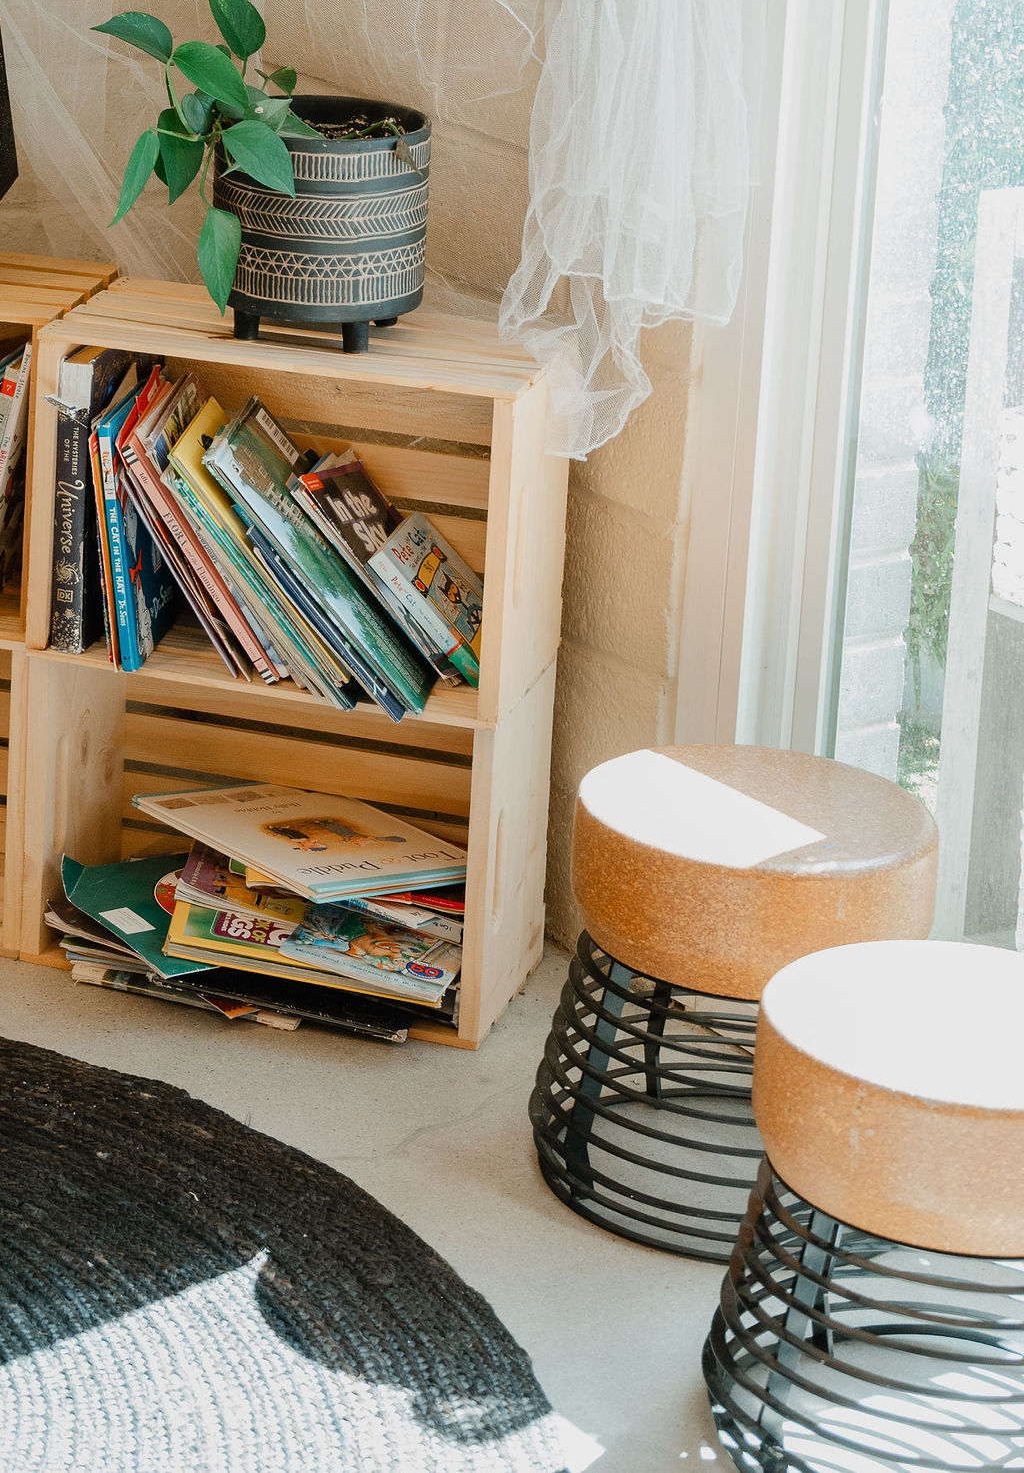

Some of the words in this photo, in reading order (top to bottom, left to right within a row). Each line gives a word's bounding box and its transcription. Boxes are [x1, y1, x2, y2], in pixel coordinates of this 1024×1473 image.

[5, 384, 12, 392] 7
[64, 438, 70, 448] OF
[71, 440, 79, 476] MYSTERIES
[325, 494, 354, 523] In
[343, 489, 378, 518] the
[56, 479, 85, 554] Universe
[109, 507, 117, 524] THE
[111, 527, 120, 544] CAT
[113, 546, 120, 556] IN
[391, 543, 414, 565] Pete
[407, 526, 427, 547] Cat
[114, 557, 122, 573] THE
[163, 512, 187, 547] FLORA
[196, 566, 221, 603] Flamingo
[116, 575, 125, 594] HAT
[391, 576, 403, 592] Pete
[406, 593, 417, 607] Cat
[58, 590, 72, 601] DK
[120, 608, 128, 627] Seuss
[406, 849, 466, 863] Toot
[296, 860, 384, 876] Puddle
[251, 930, 268, 944] OF
[409, 963, 440, 978] 60
